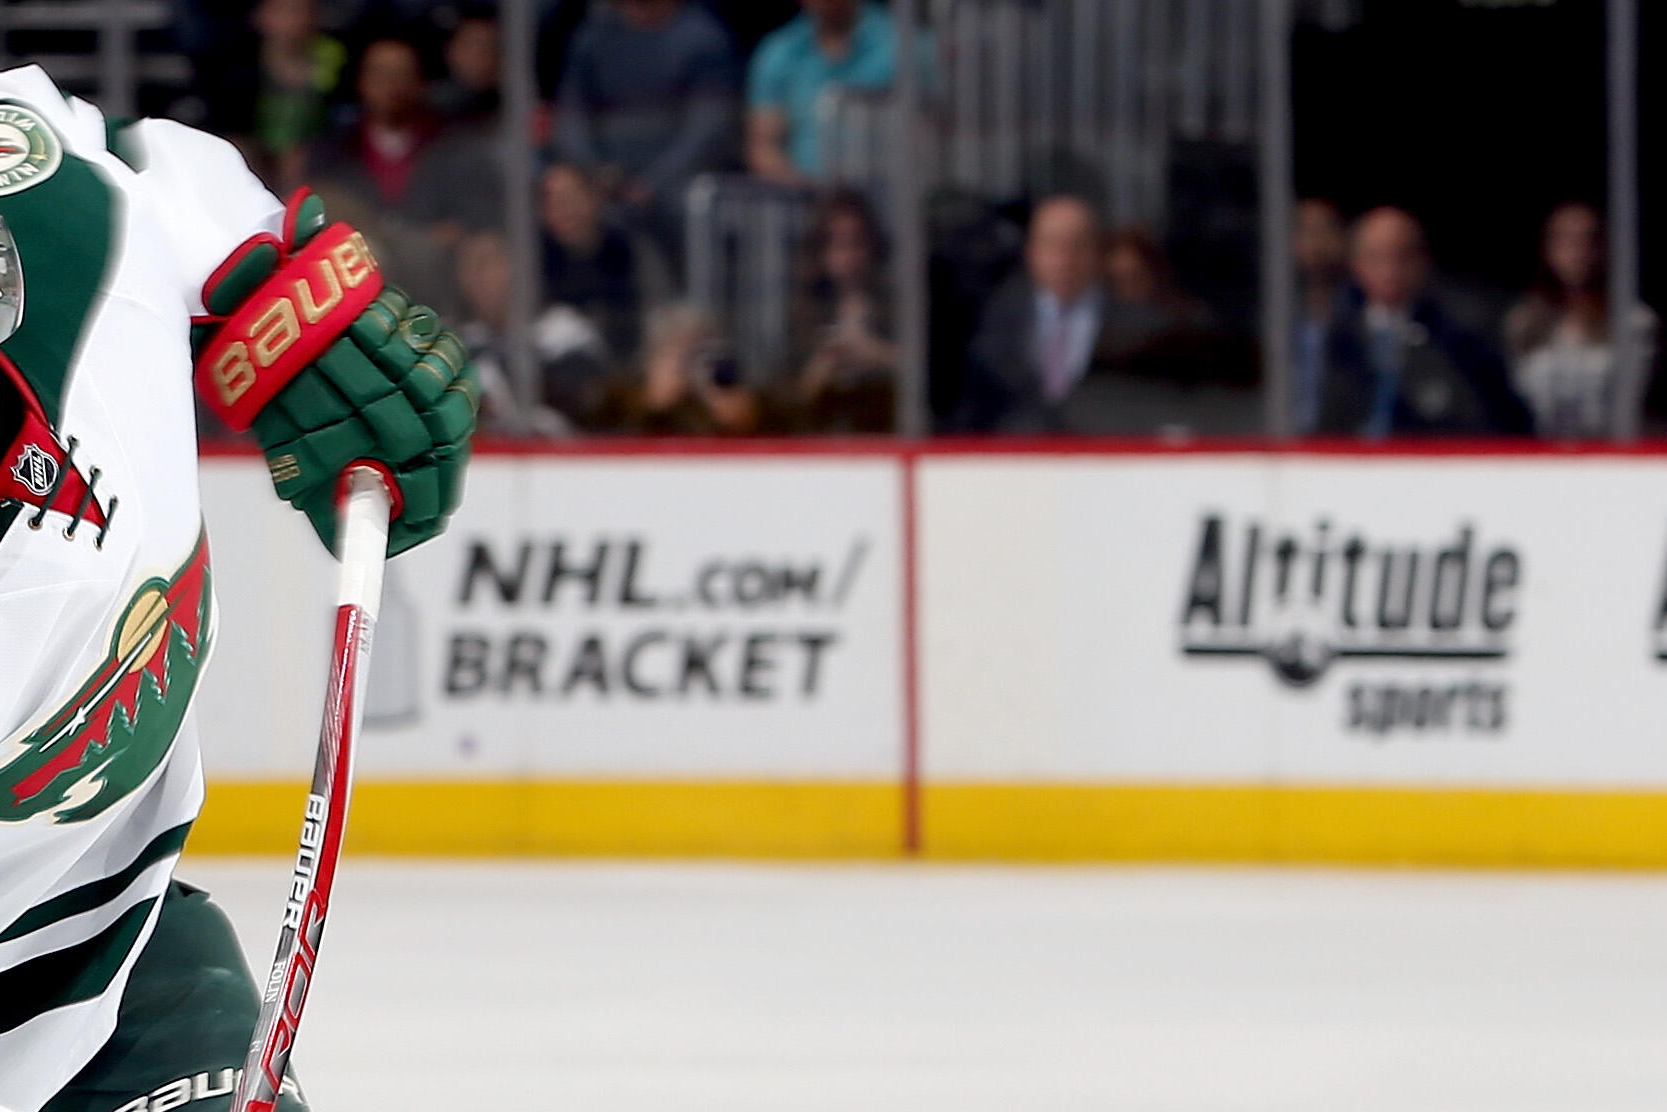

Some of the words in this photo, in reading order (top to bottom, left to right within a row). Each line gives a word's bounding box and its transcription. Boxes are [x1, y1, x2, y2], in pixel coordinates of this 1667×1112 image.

[1180, 513, 1522, 631] Altitude
[442, 630, 839, 698] BRACKET
[1343, 680, 1509, 738] sports
[283, 792, 328, 931] BAUER
